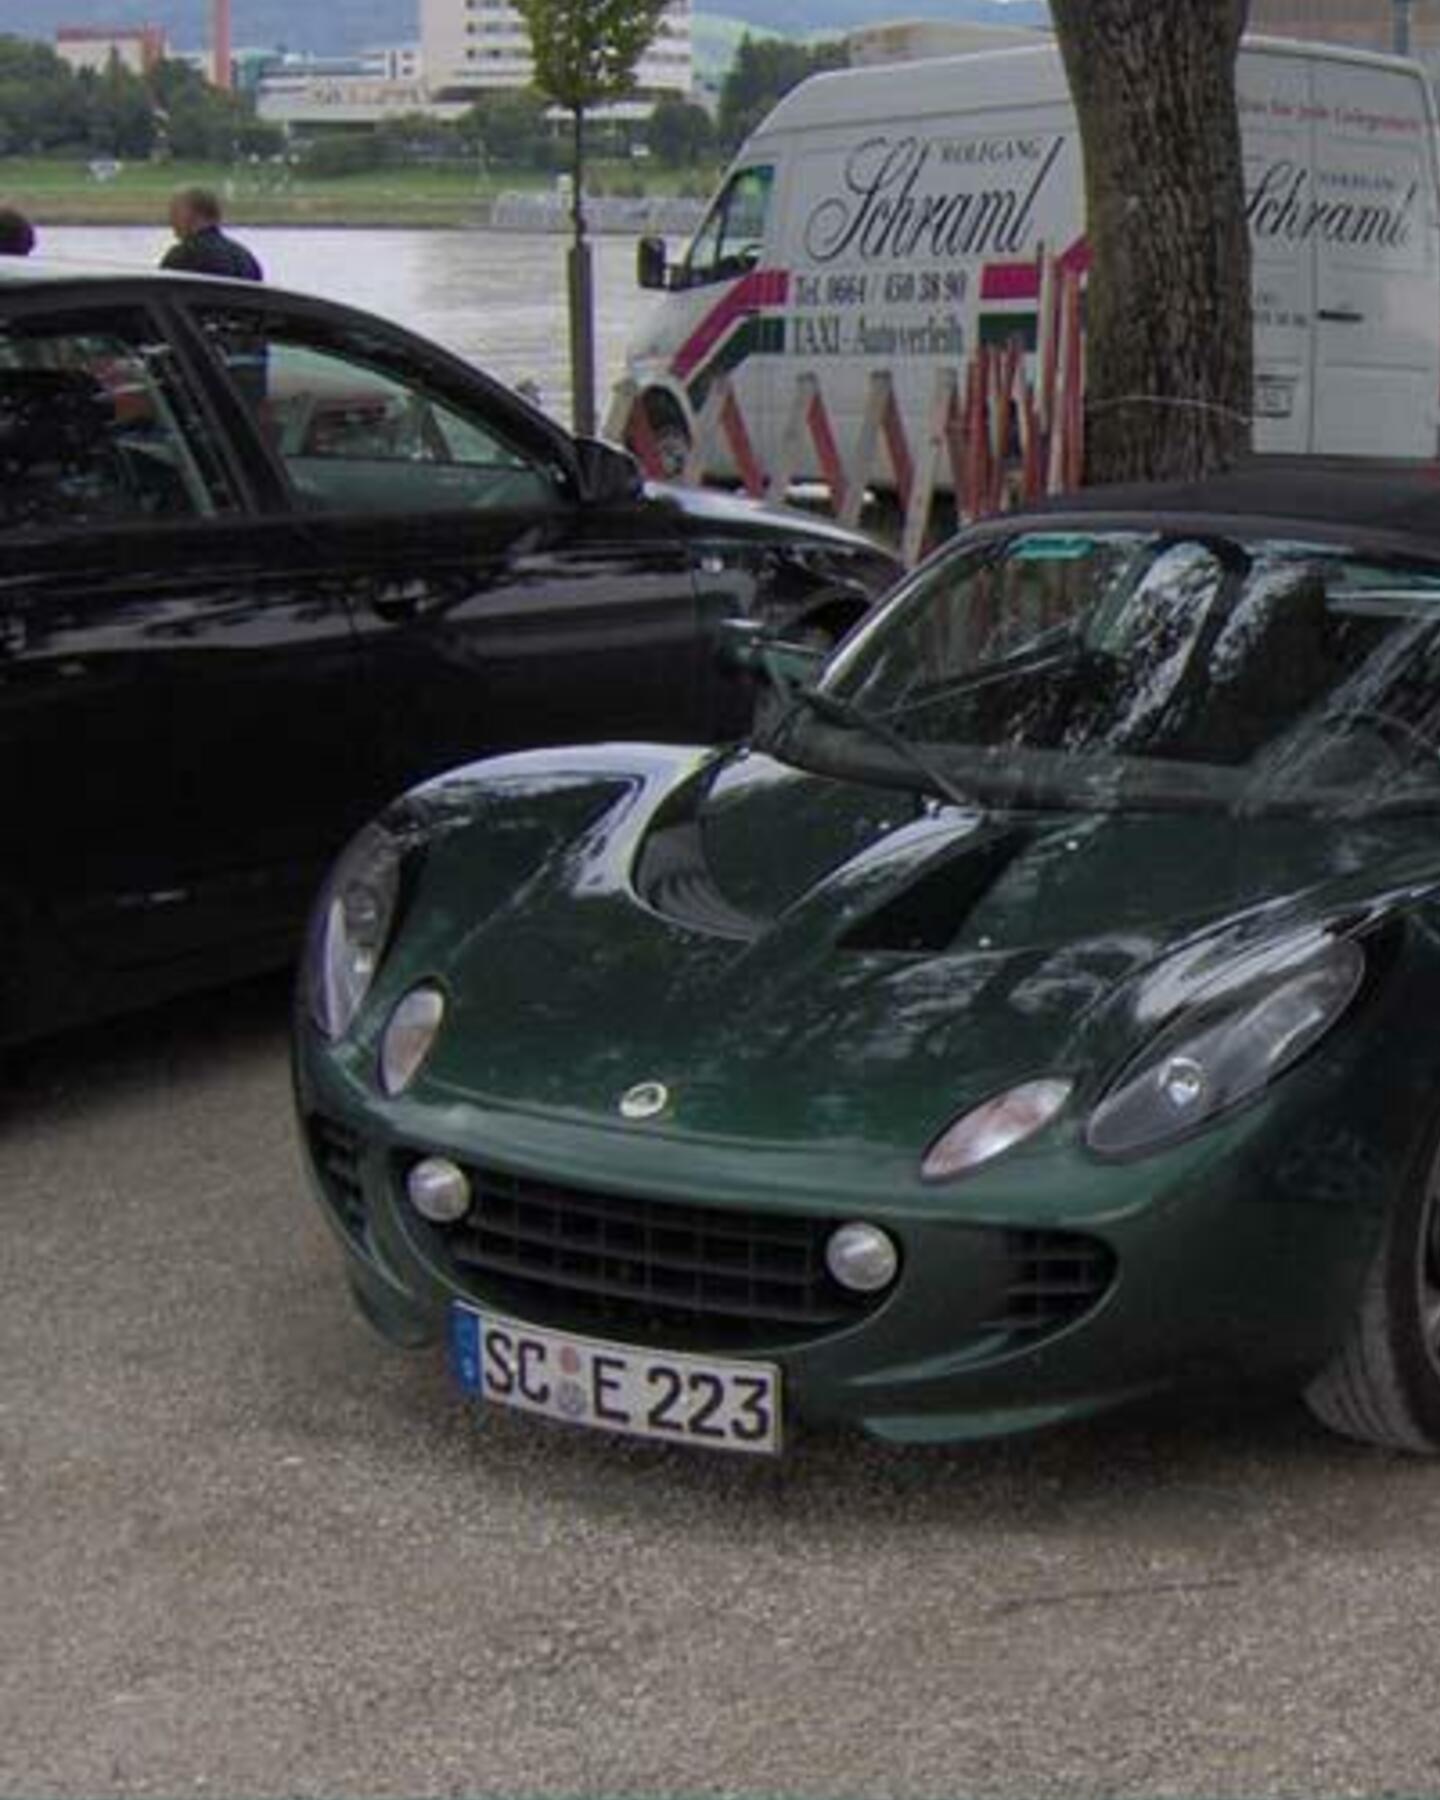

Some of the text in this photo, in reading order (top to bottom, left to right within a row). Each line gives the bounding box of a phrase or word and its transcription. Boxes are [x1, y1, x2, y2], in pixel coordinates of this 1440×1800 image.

[485, 1330, 770, 1441] SC E 223
